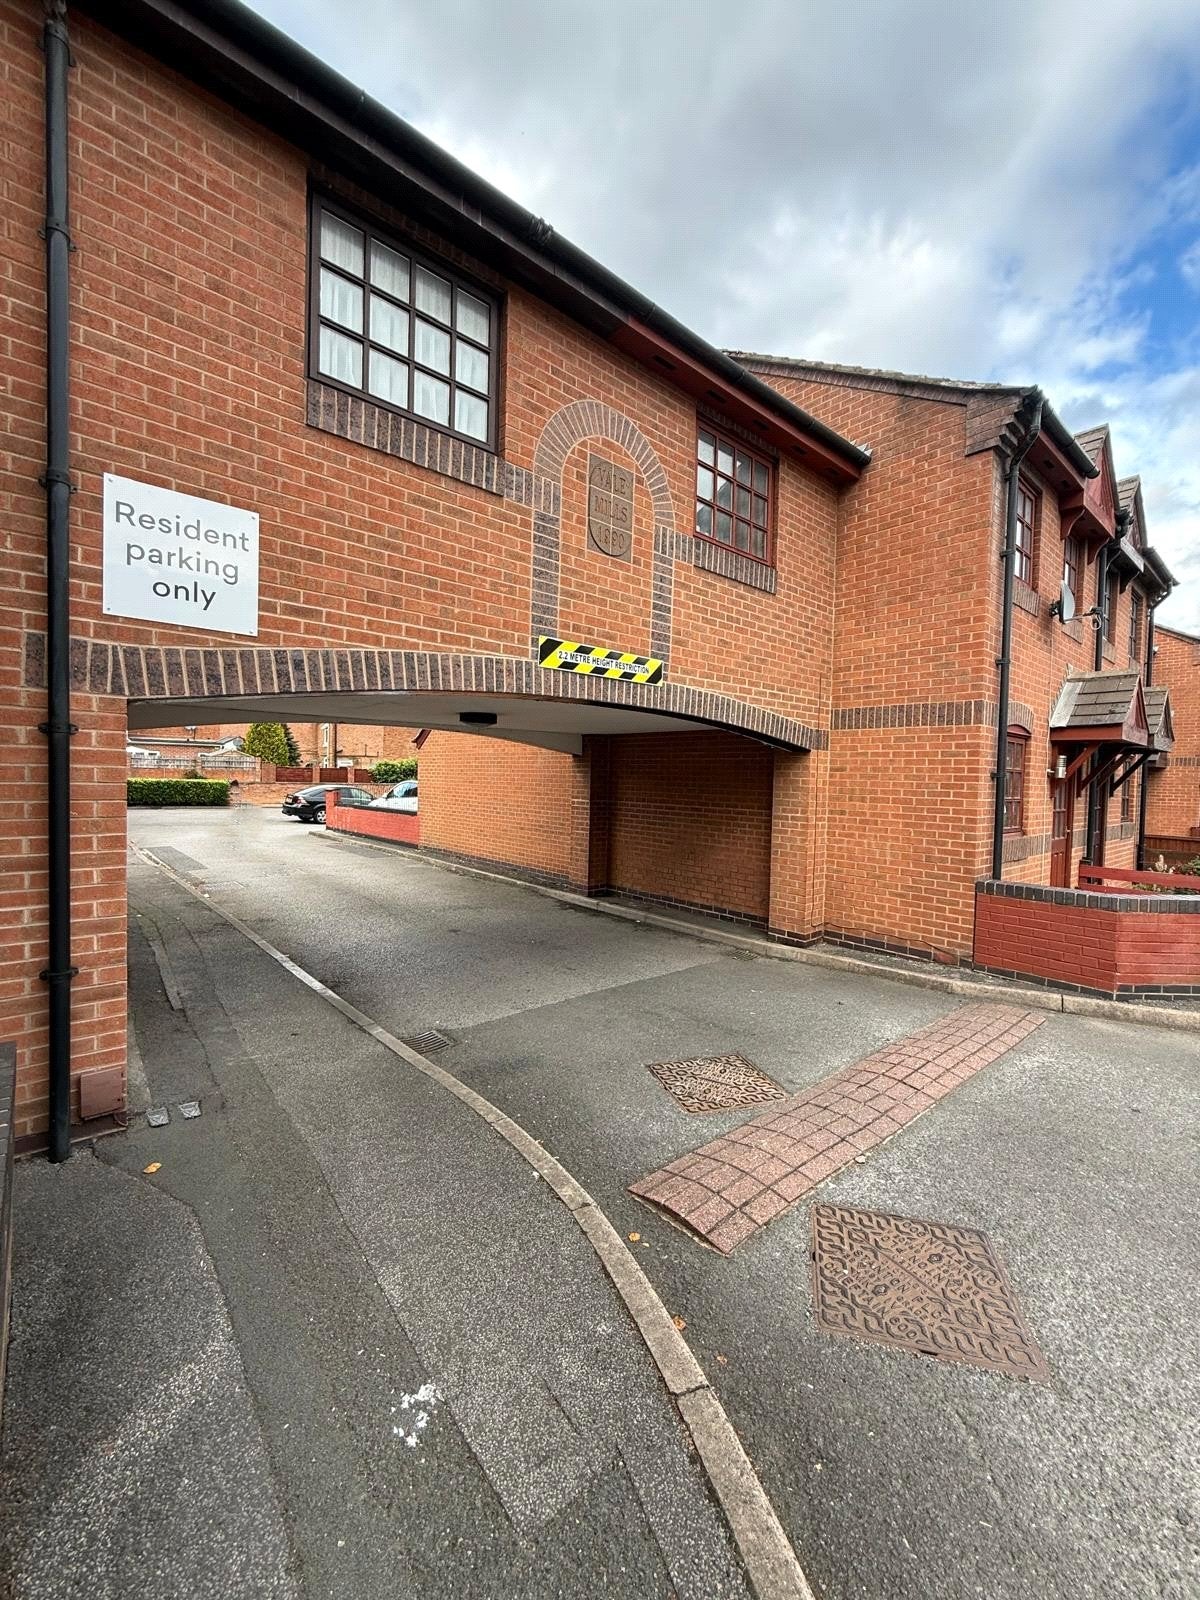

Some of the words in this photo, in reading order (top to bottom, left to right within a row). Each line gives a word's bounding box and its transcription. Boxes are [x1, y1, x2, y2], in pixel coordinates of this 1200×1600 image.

[599, 468, 626, 495] VALE
[594, 495, 628, 523] MILLS
[115, 500, 250, 552] Resident
[126, 542, 239, 585] parking
[152, 581, 216, 611] only
[558, 650, 568, 660] 2.2
[569, 652, 591, 664] METRE
[591, 656, 614, 667] HEIGHT
[614, 661, 650, 674] RESTRICTION
[820, 1260, 894, 1319] CHIEFTAIN
[886, 1314, 919, 1340] 600
